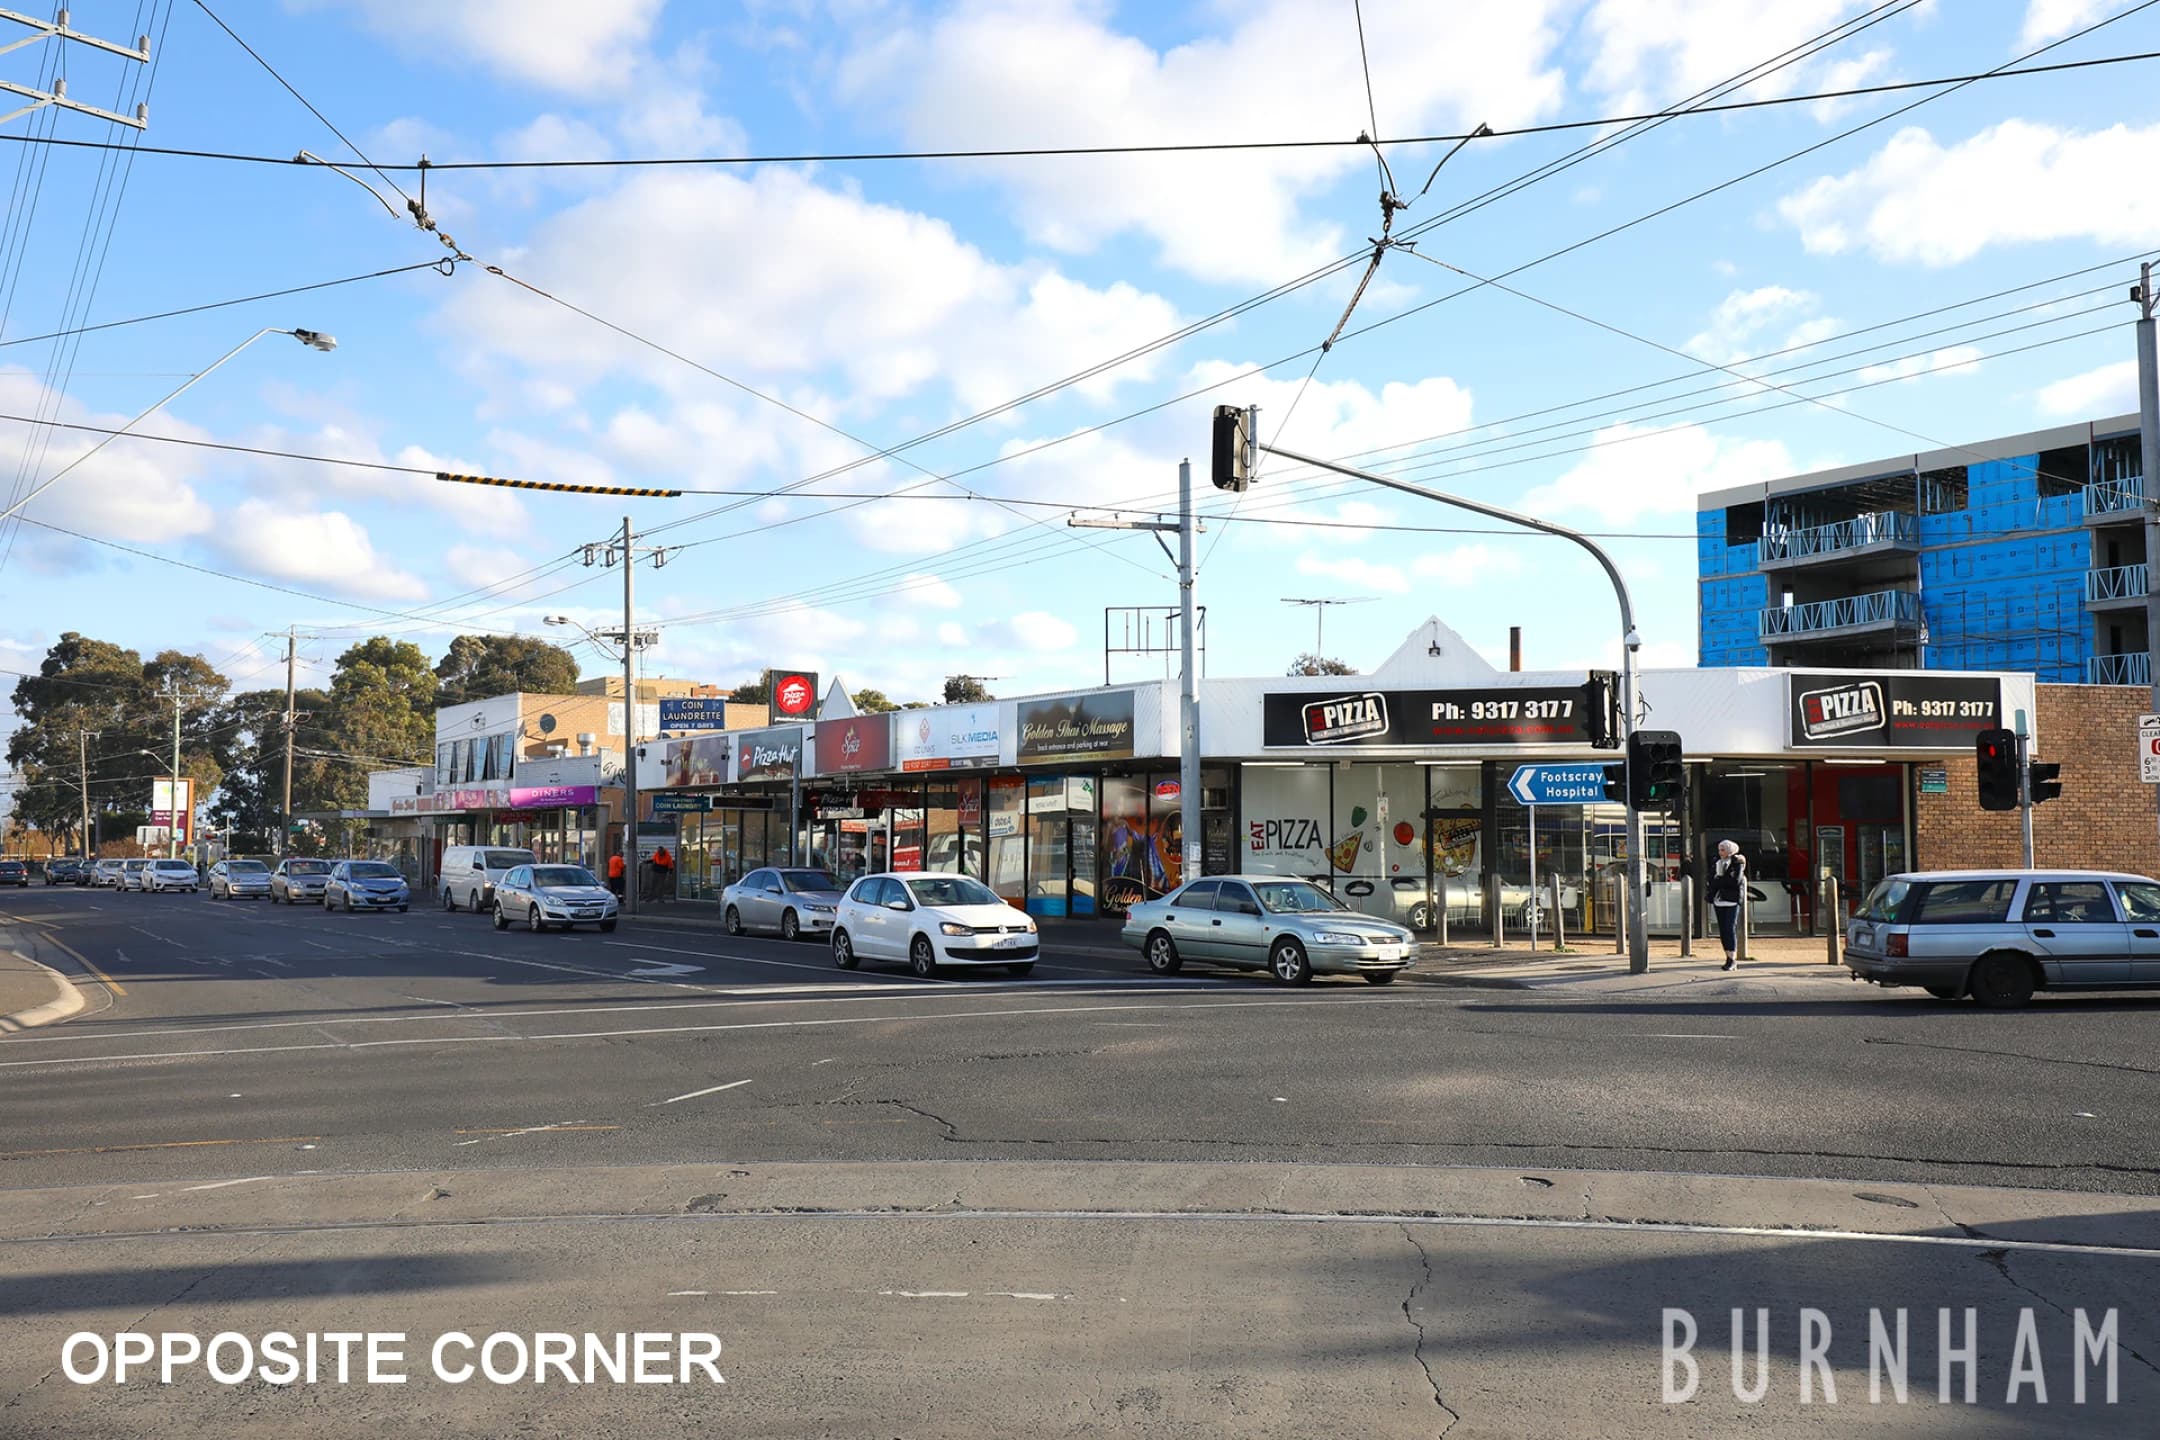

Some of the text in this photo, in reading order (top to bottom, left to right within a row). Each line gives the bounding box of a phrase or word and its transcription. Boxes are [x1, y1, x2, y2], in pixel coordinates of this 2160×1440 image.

[681, 701, 704, 710] COIN
[782, 691, 806, 702] Pizza
[1821, 689, 1876, 721] PIZZA
[663, 711, 721, 721] LAUNDRETTE
[1323, 698, 1380, 729] PIZZA
[1431, 699, 1574, 720] Ph: 9317 3177
[1892, 701, 1995, 717] Ph: 9317 3177
[1021, 717, 1128, 747] Golden Thai Massage
[752, 743, 799, 768] Pizza Hut
[1540, 771, 1603, 785] Footscray
[531, 788, 575, 798] DINERS
[1546, 786, 1599, 800] Hospital
[1250, 821, 1264, 850] EAT
[1266, 820, 1323, 849] PIZZA
[1104, 883, 1142, 908] Golden
